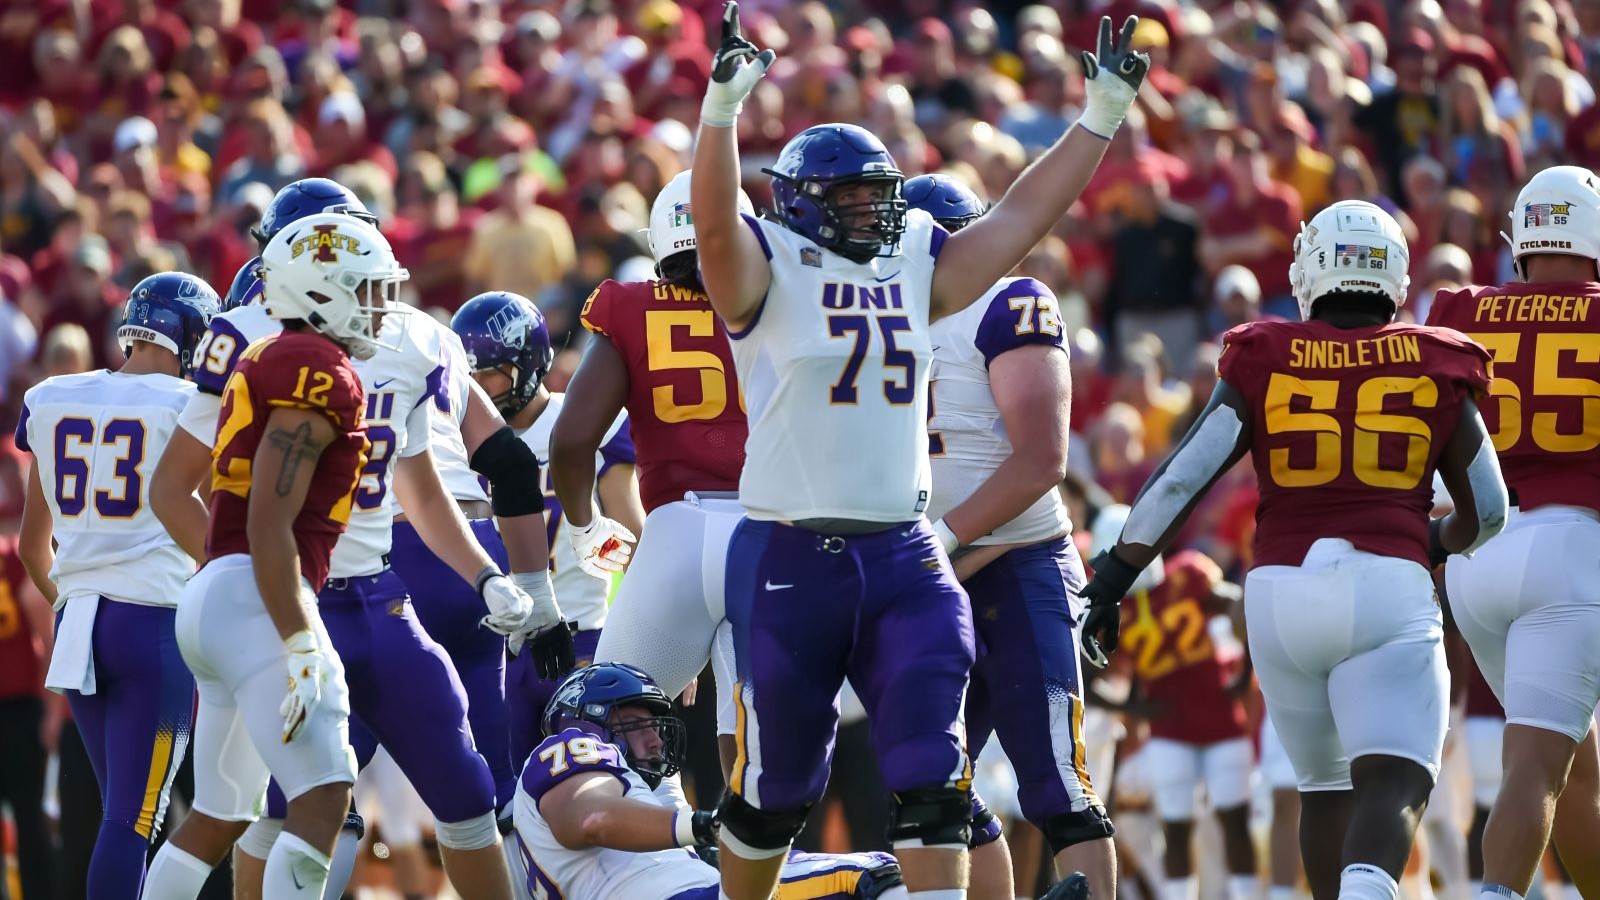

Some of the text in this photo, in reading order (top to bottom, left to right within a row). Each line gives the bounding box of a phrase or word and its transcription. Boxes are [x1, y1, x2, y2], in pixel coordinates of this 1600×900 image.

[1554, 217, 1567, 225] 55
[291, 233, 361, 260] STATE
[674, 239, 696, 249] CYCL
[1370, 260, 1383, 269] 56
[654, 283, 708, 301] UWA
[822, 283, 903, 309] UNI
[1008, 296, 1060, 337] 72
[1475, 296, 1591, 323] PETERSEN
[119, 327, 156, 341] ANTHERS
[645, 310, 749, 424] 5
[826, 314, 917, 407] 75
[1289, 336, 1422, 369] SINGLETON
[291, 366, 335, 407] 12
[1265, 372, 1439, 490] 56
[53, 415, 148, 521] 63
[539, 737, 602, 777] 79
